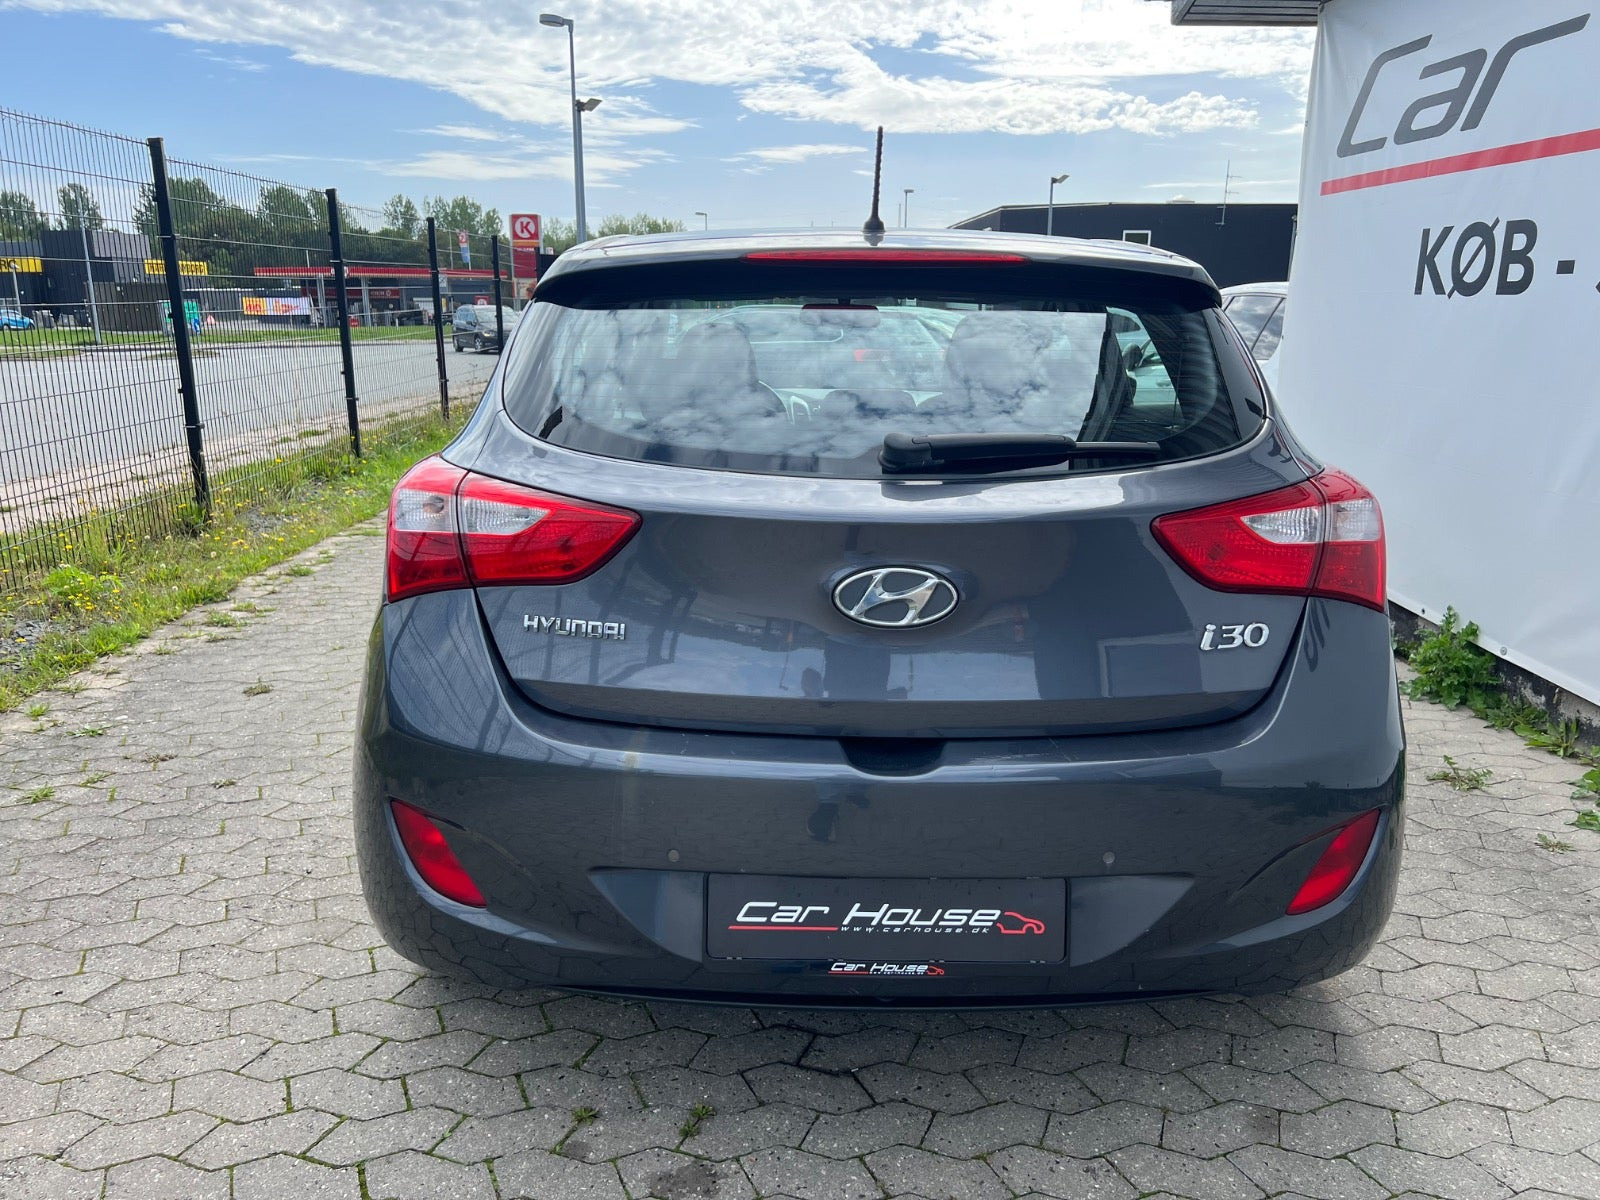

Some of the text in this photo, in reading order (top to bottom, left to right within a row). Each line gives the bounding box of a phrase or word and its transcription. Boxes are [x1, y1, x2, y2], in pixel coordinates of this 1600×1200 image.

[1337, 13, 1591, 158] Car
[520, 221, 534, 236] K
[1414, 217, 1538, 299] KØB
[523, 614, 626, 640] HYUNDAI
[1200, 622, 1270, 651] i30
[736, 901, 1001, 926] Car House
[840, 926, 990, 935] www.carhouse.dk
[830, 962, 929, 973] Car House
